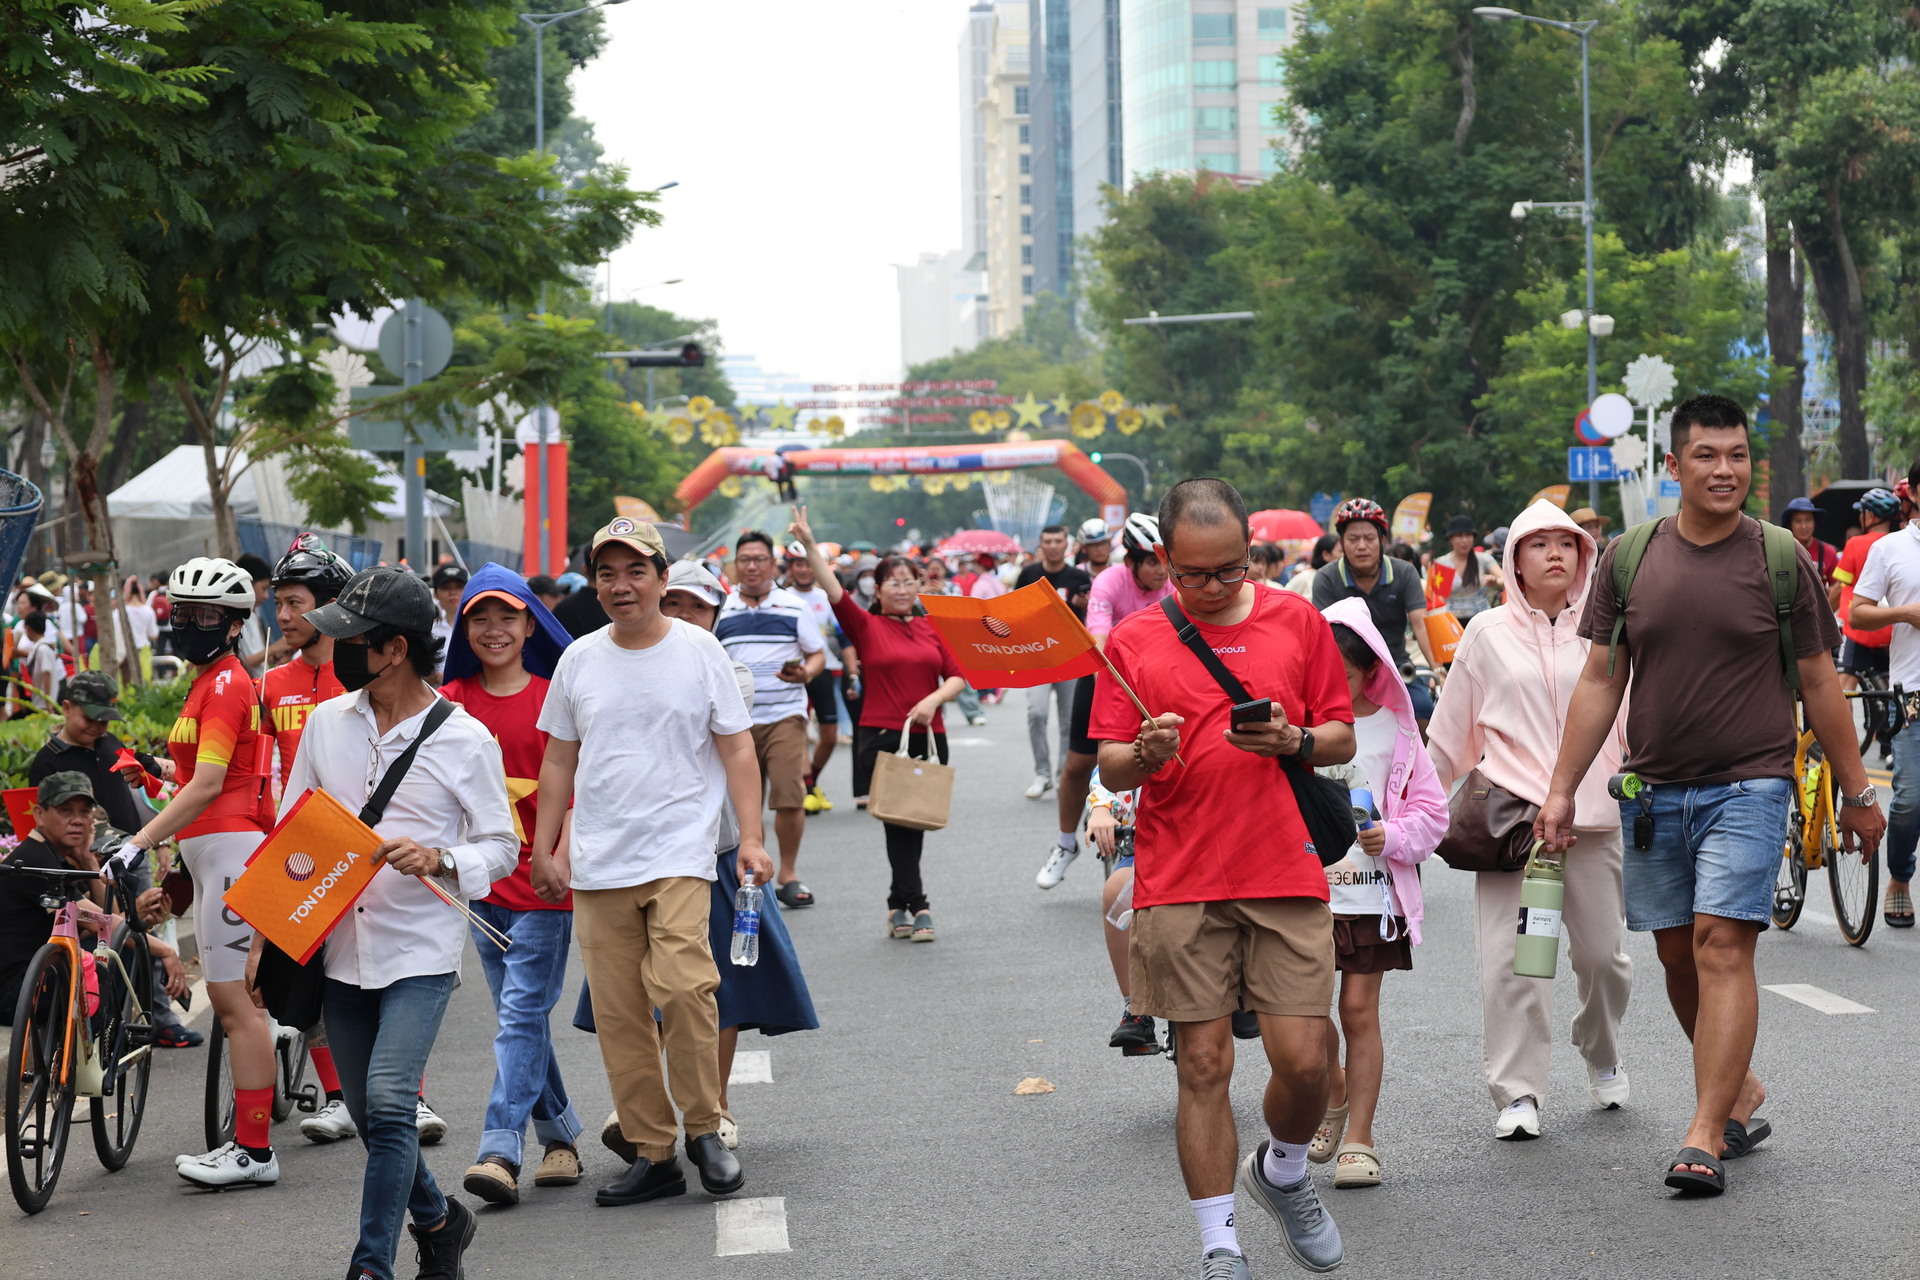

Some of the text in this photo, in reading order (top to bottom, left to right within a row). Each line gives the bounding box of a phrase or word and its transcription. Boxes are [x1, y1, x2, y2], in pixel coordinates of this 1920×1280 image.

[972, 636, 1060, 655] TON DONG A
[288, 851, 361, 924] TON DONG A
